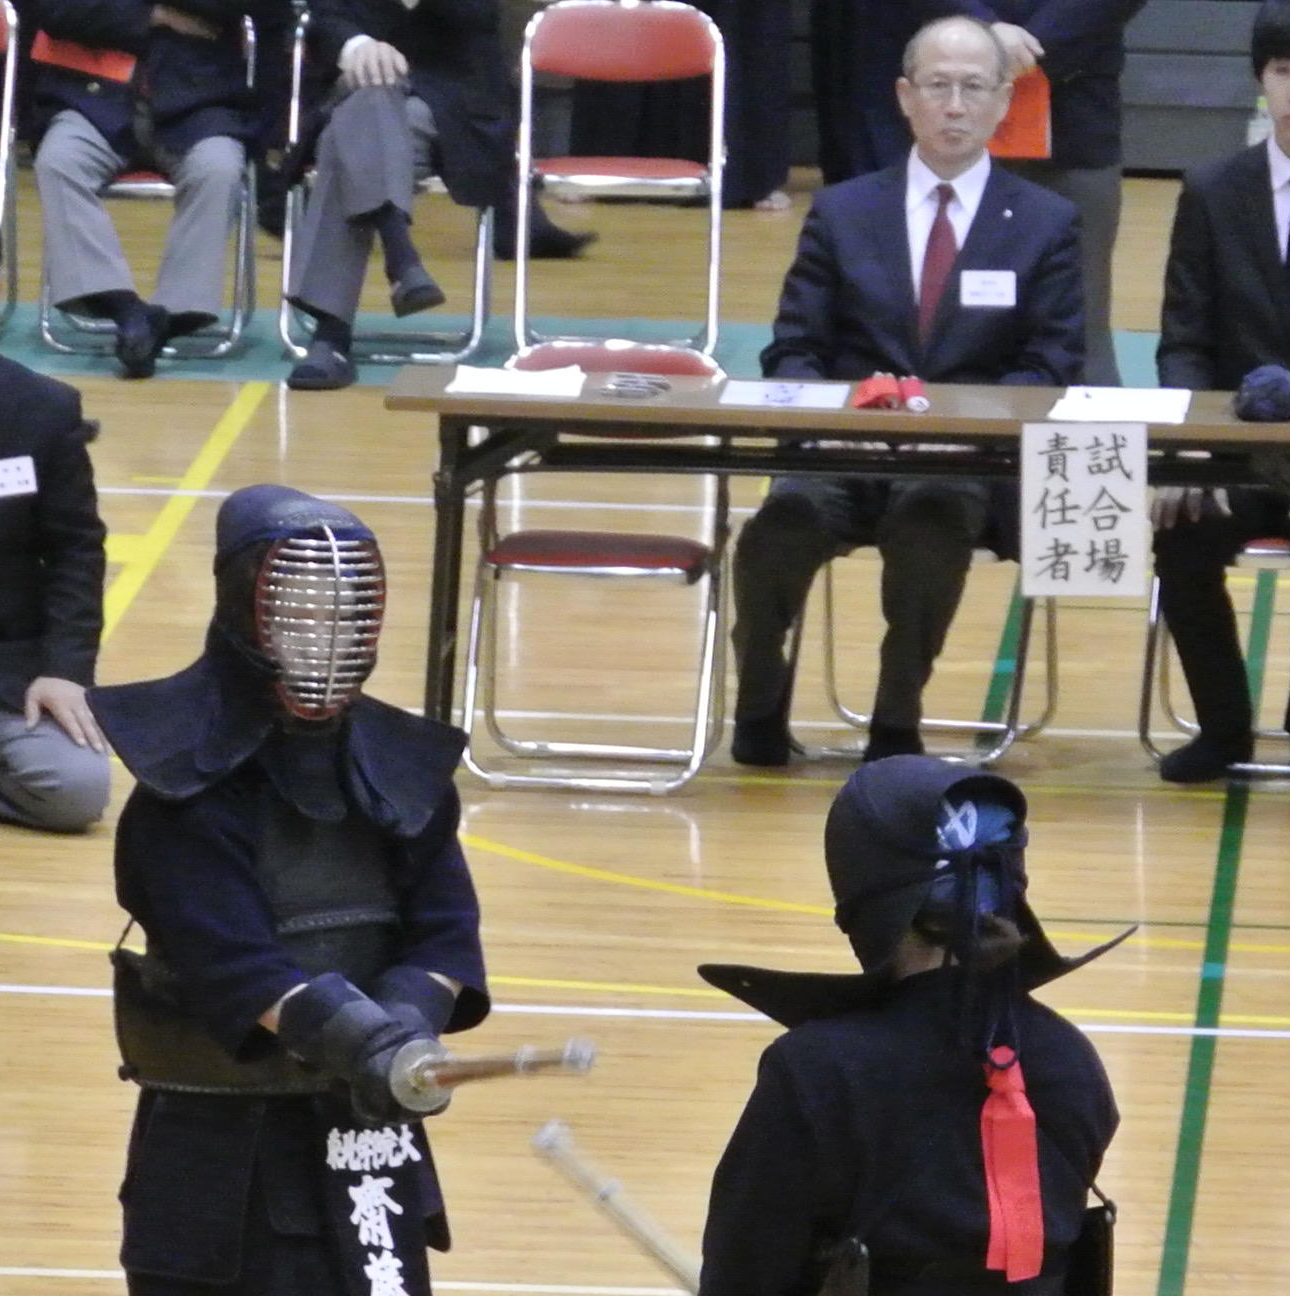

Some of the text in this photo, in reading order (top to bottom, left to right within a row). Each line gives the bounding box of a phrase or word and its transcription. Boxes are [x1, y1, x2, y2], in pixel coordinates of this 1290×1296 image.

[1033, 432, 1081, 582] 責任者
[1083, 432, 1134, 583] 試合場
